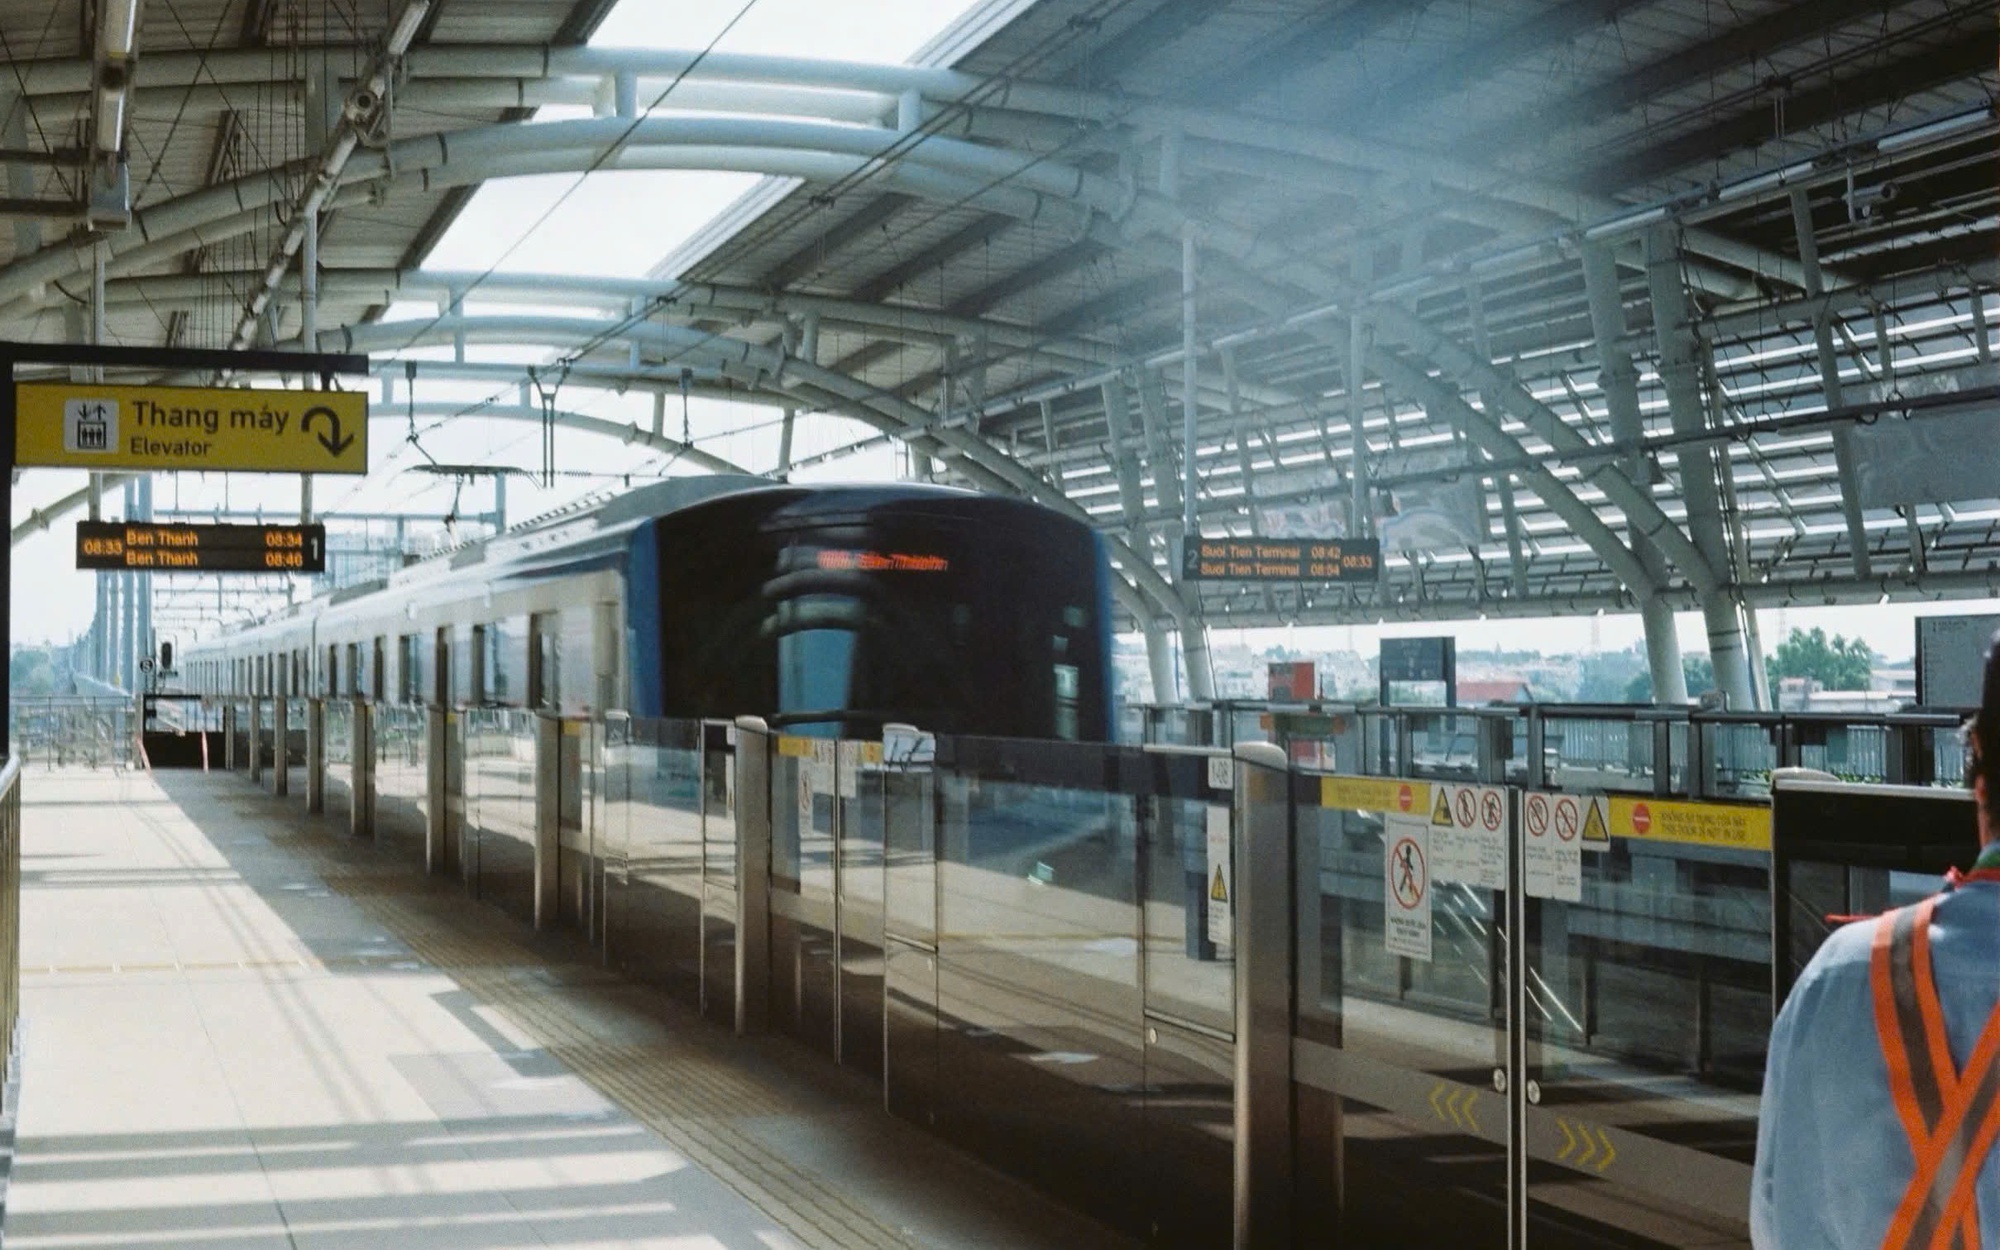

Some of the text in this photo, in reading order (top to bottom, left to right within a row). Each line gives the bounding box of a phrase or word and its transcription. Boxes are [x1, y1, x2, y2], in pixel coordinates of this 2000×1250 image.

[132, 400, 289, 435] Thang máy
[129, 436, 212, 457] Elevator
[127, 528, 303, 547] Ben Thanh 08:34
[127, 549, 154, 566] Ben
[156, 549, 199, 566] Thanh
[310, 537, 319, 560] 1
[1187, 549, 1199, 569] 2
